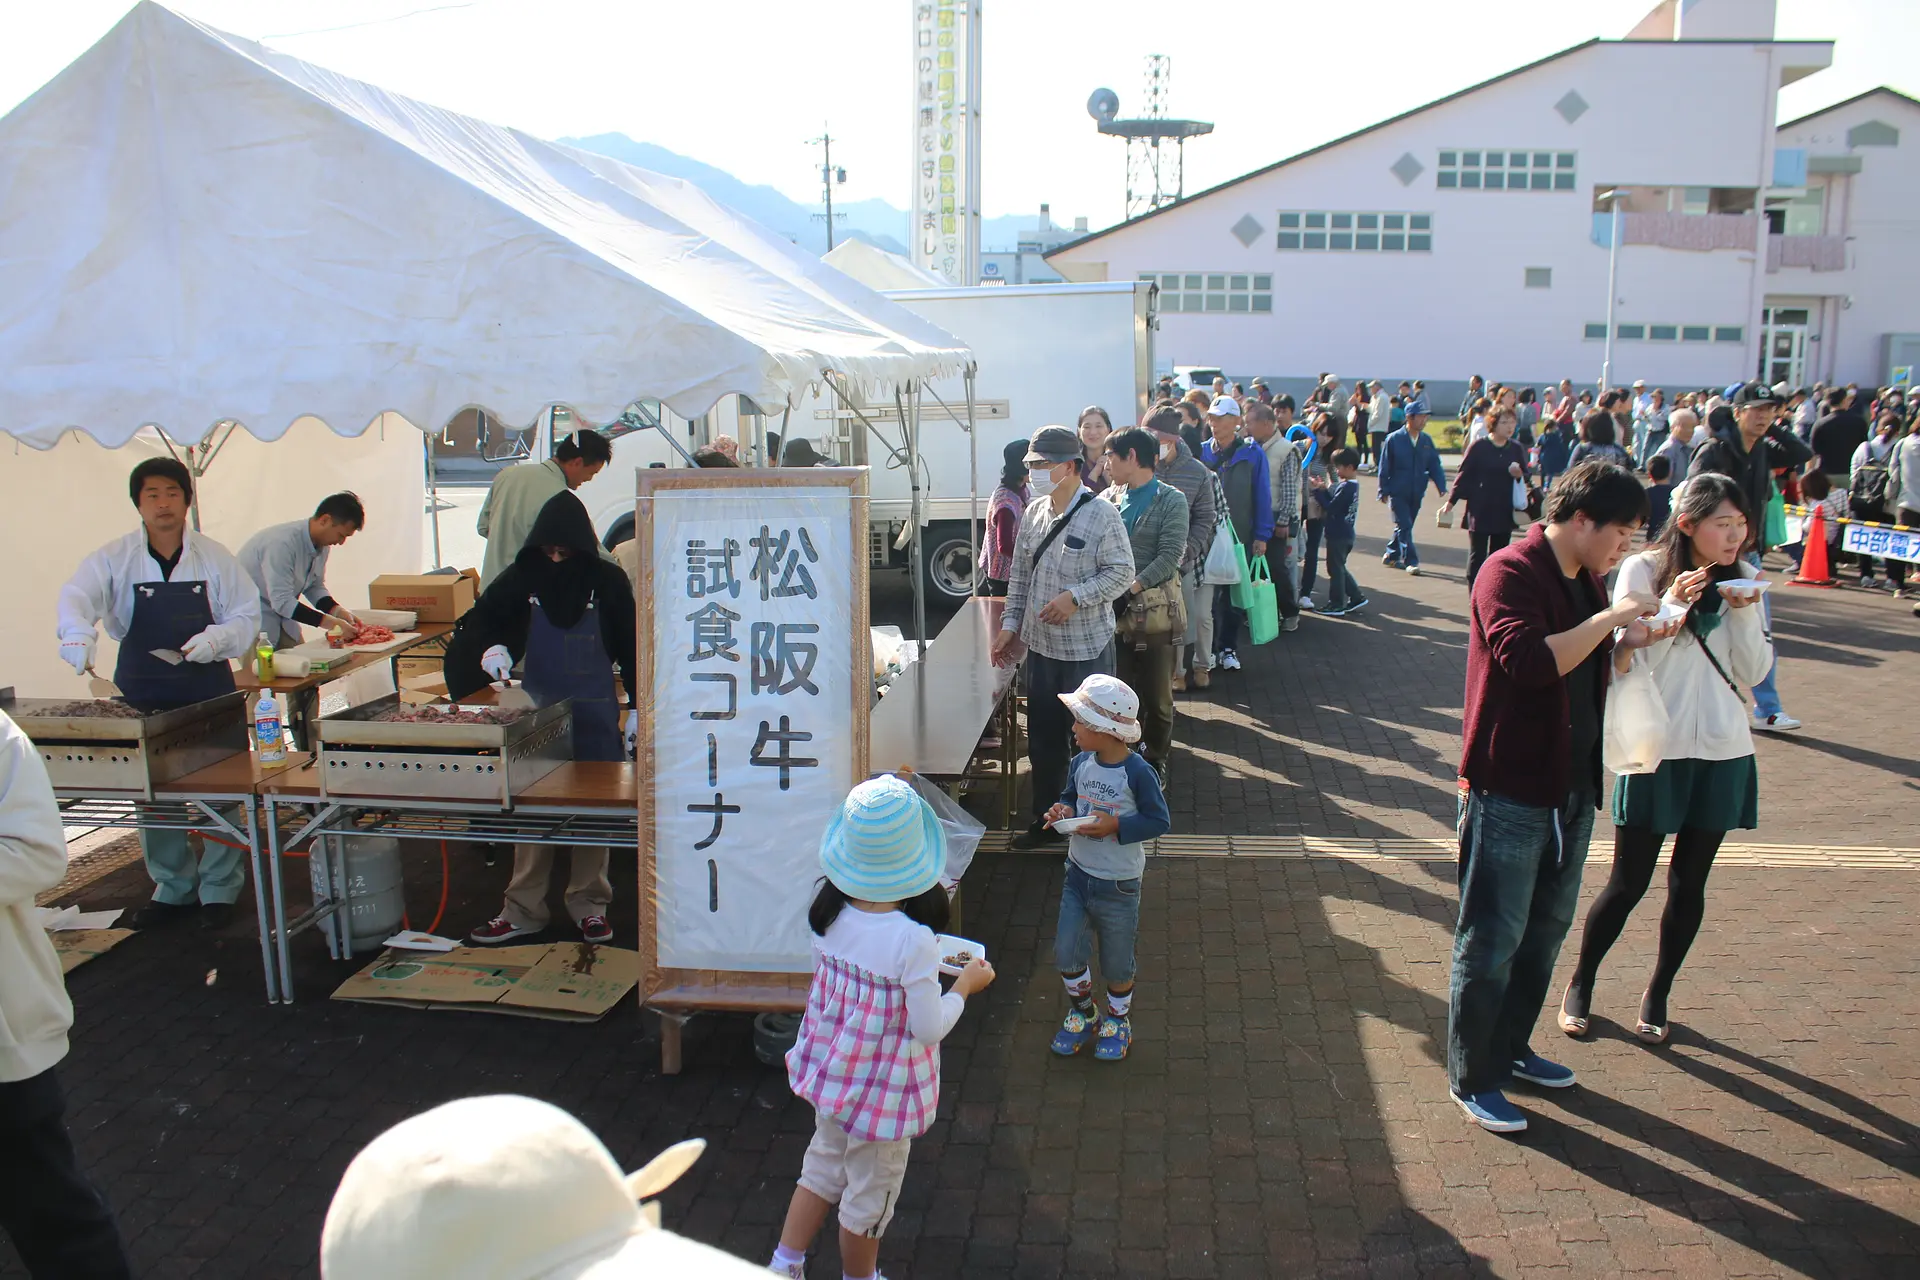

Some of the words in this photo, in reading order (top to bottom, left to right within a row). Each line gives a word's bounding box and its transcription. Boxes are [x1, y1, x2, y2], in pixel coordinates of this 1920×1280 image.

[685, 537, 742, 913] 試食コーナー
[749, 524, 819, 792] 松阪牛
[1082, 779, 1120, 799] Wrangler
